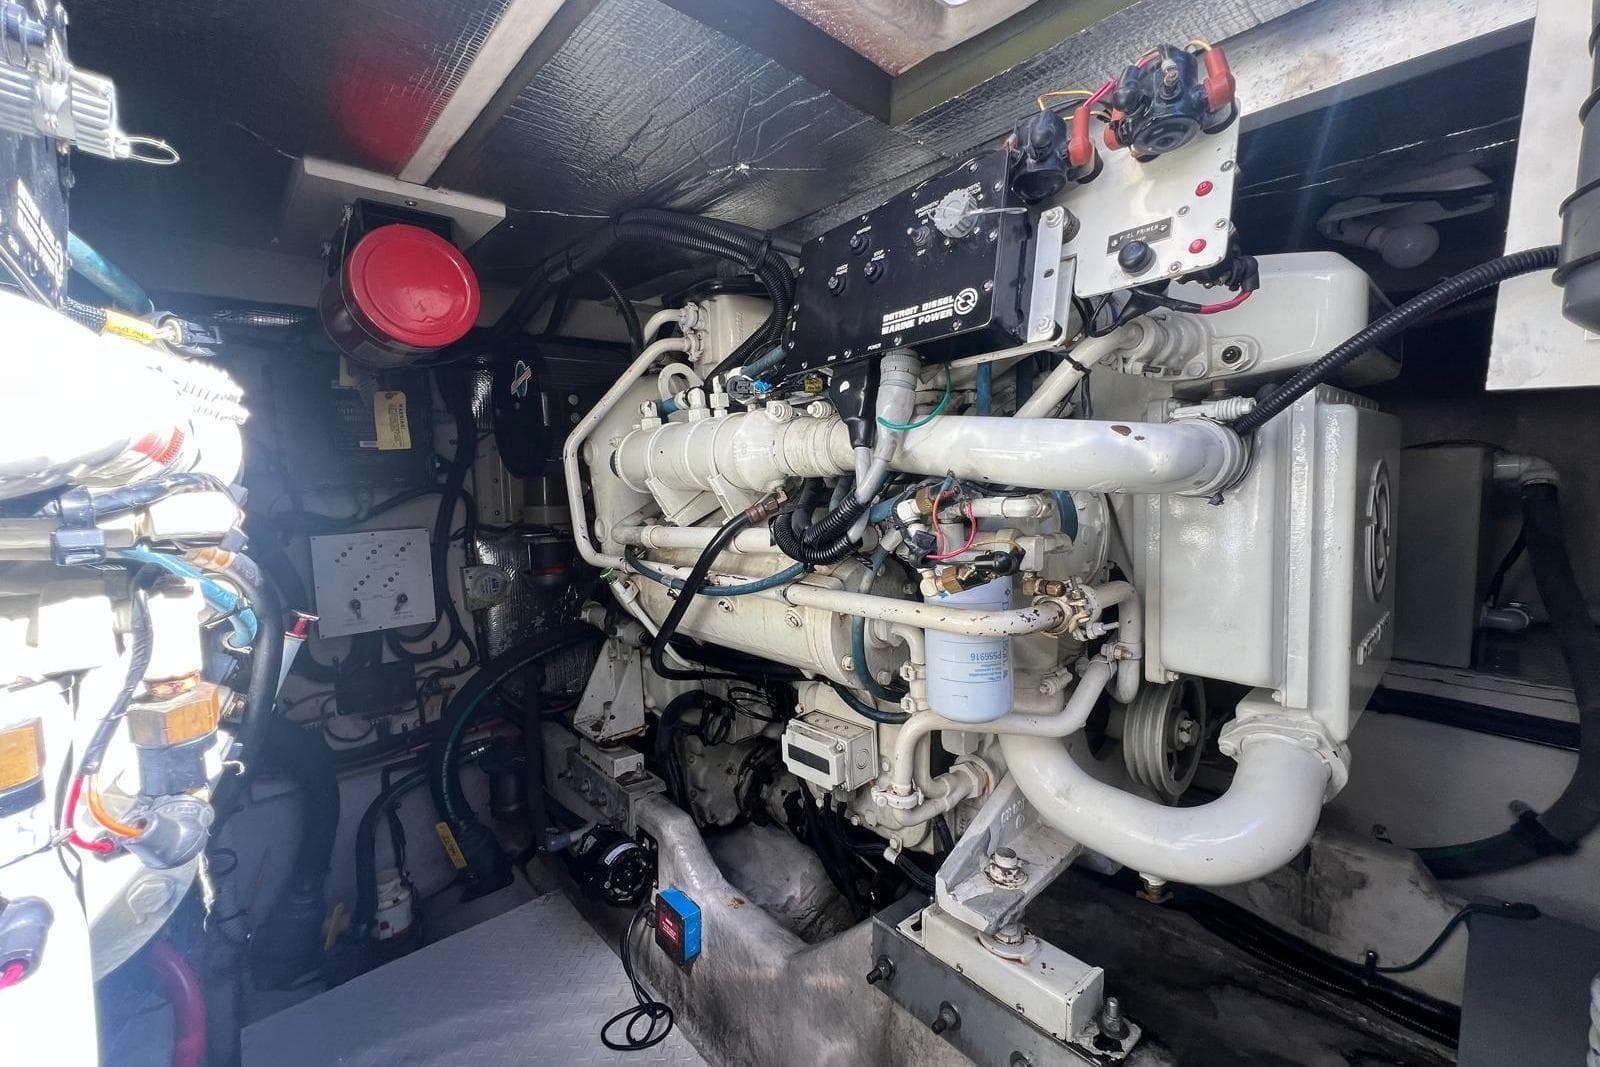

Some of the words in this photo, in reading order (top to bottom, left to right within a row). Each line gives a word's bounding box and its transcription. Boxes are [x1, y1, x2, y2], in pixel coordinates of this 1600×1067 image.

[881, 318, 916, 335] MARINE
[917, 308, 954, 325] POWER
[882, 305, 919, 323] DETROIT
[921, 295, 955, 311] DIESEL
